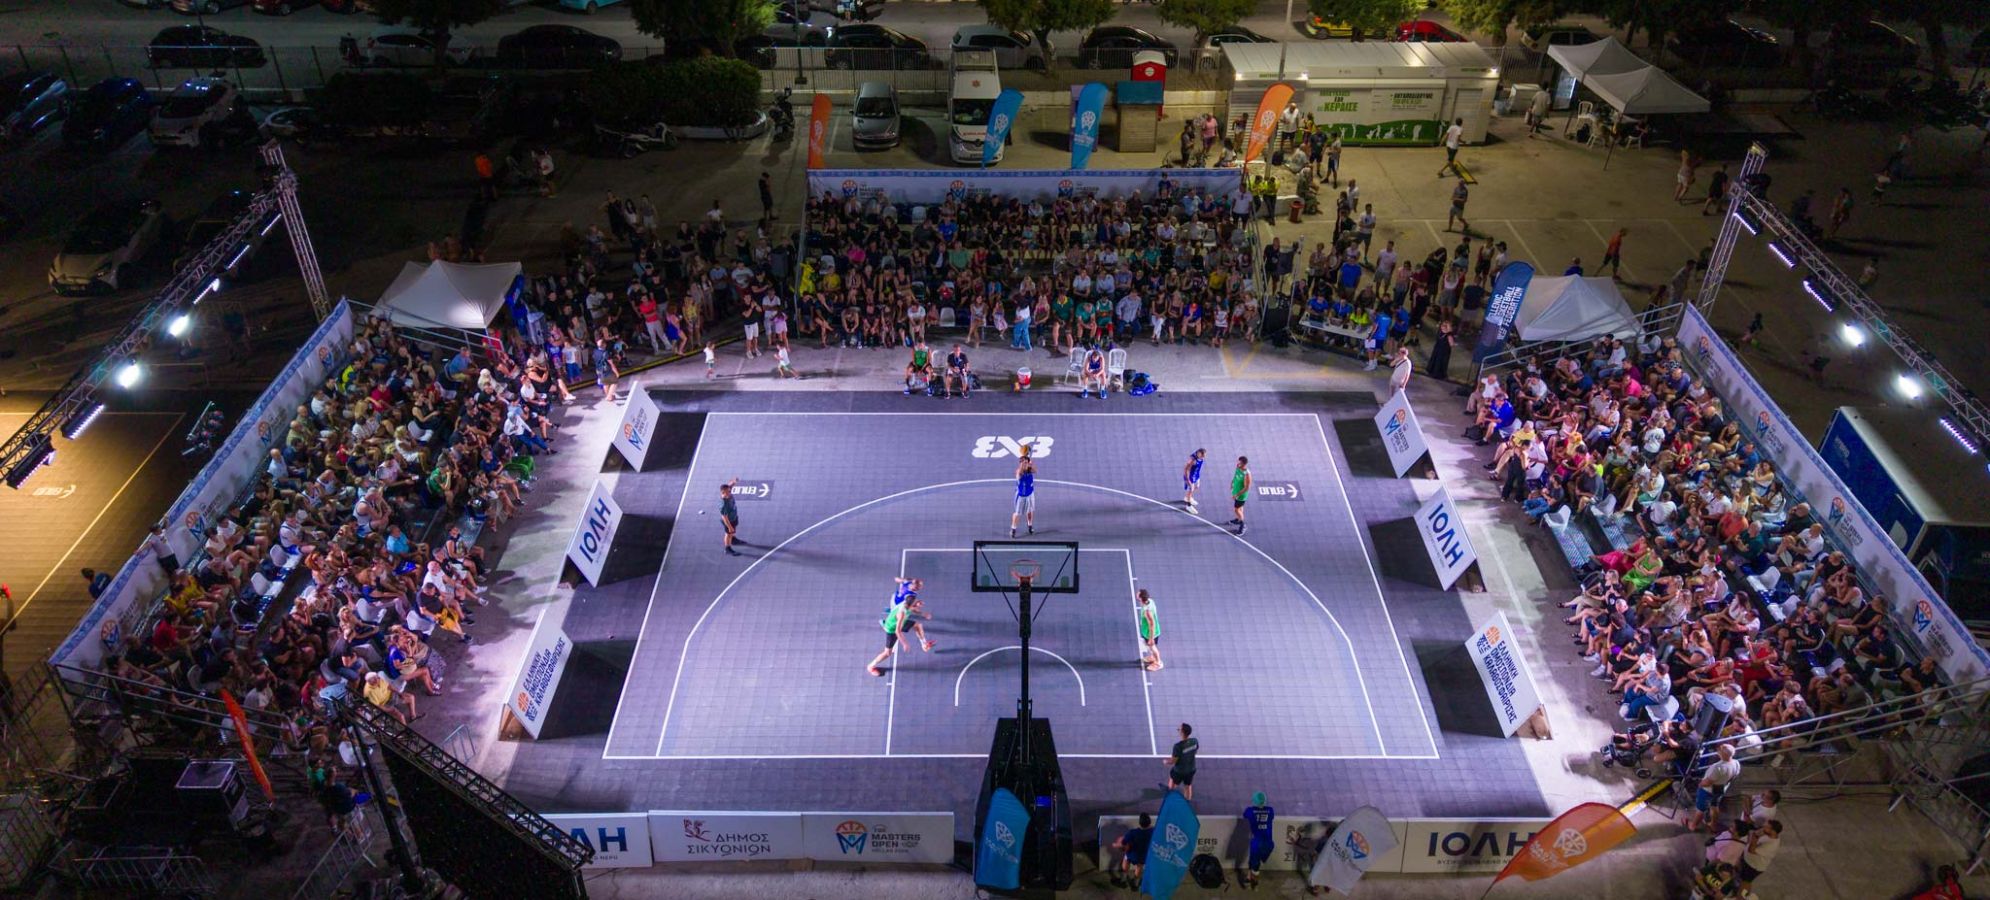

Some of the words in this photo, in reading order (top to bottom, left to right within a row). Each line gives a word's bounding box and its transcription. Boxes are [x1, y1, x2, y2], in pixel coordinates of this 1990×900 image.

[522, 651, 542, 691] ΕΛΛΗΝΙΚΗ
[528, 648, 552, 699] ΟΜΟΣΠΟΝΔΙΑ
[1490, 647, 1517, 697] ΟΜΟΣΠΟΝΔΙΑ
[1497, 640, 1519, 680] ΕΛΛΗΝΙΚΗ
[716, 833, 769, 843] ΔΗΜΟΣ
[872, 833, 921, 841] MASTERS
